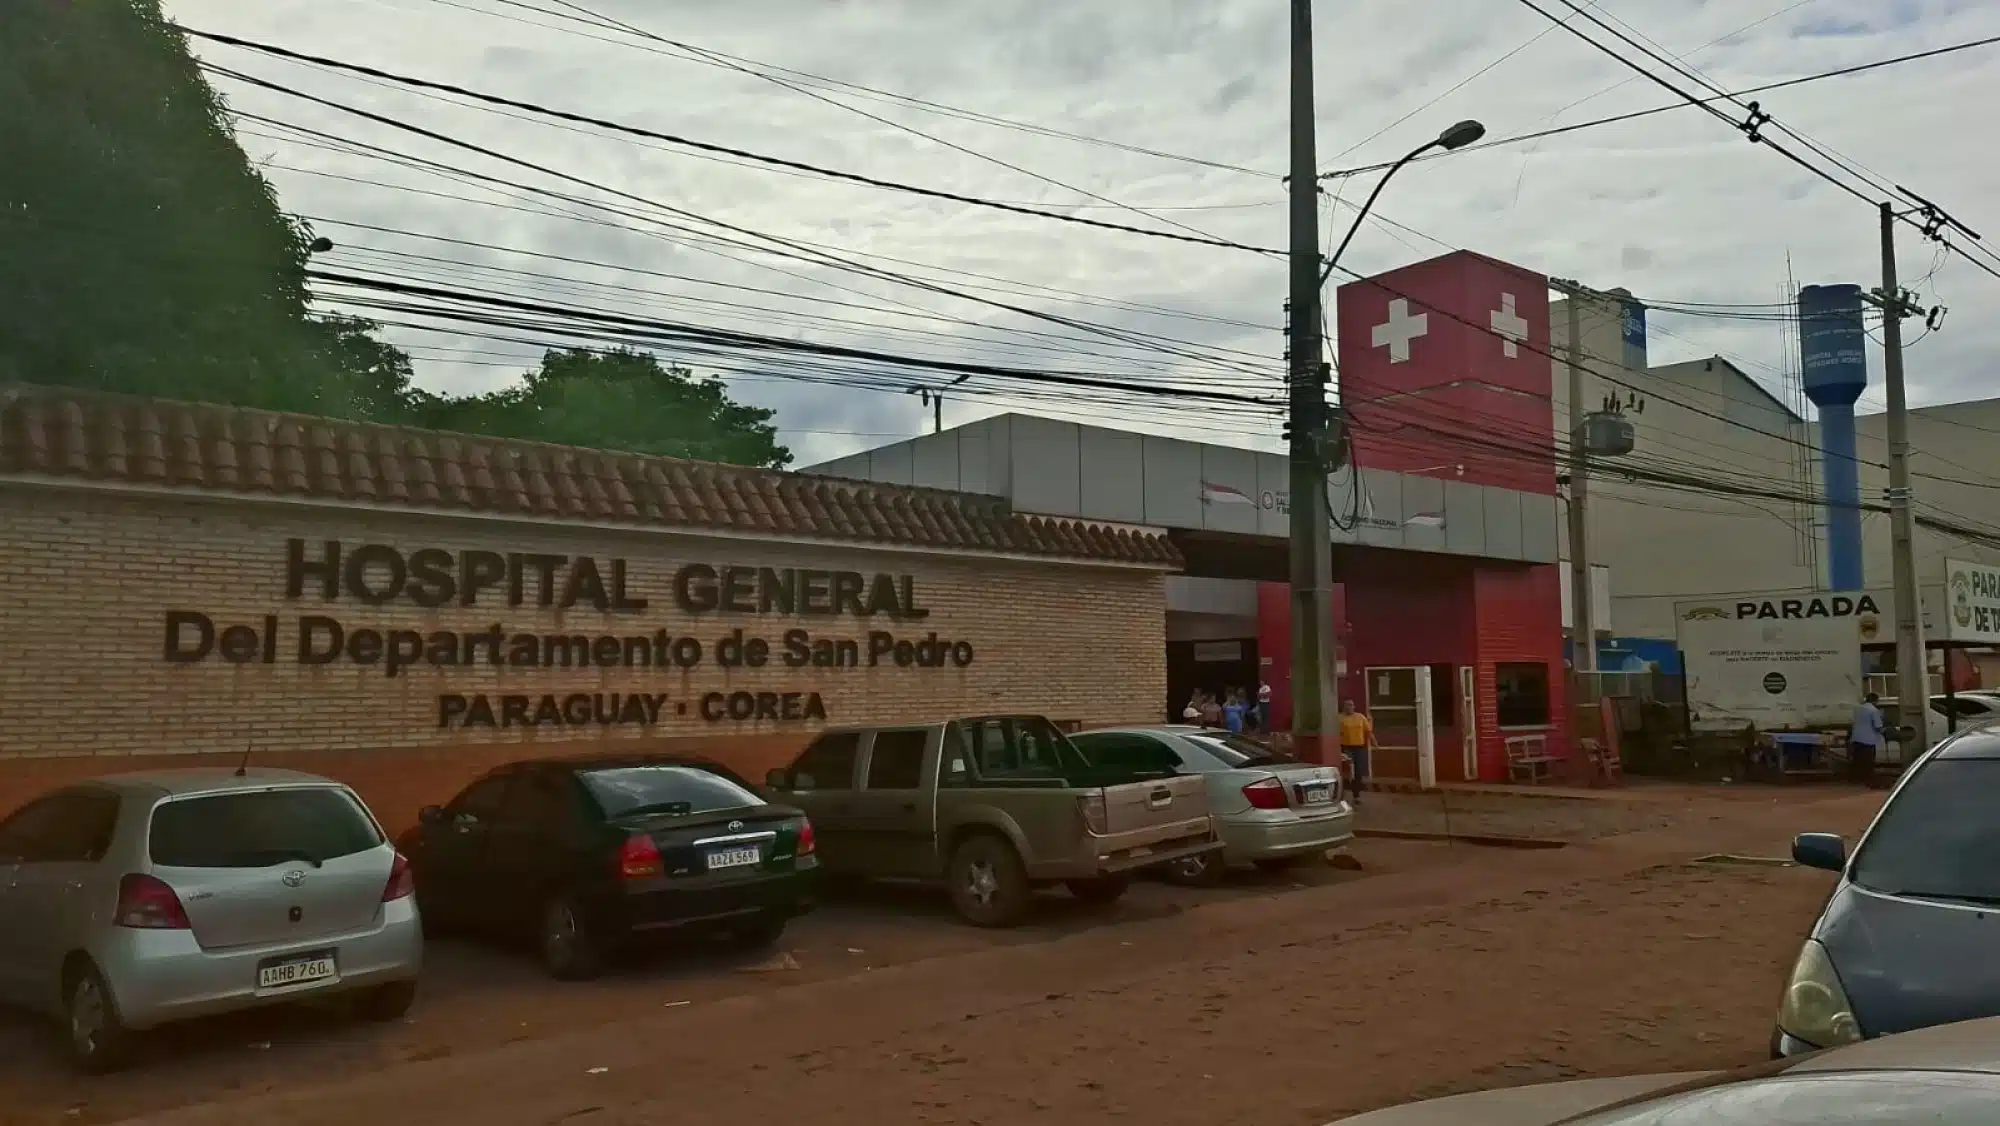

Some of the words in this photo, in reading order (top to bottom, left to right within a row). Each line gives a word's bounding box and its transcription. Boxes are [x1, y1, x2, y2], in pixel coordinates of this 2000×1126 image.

[286, 538, 648, 614] HOSPITAL
[672, 562, 930, 620] GENERAL
[1971, 570, 2000, 599] PAR
[1735, 595, 1880, 620] PARADA
[1974, 605, 1990, 633] DE
[164, 611, 278, 664] Del
[298, 614, 701, 678] Departamento
[715, 628, 770, 668] de
[781, 629, 859, 668] San
[867, 630, 975, 668] Pedro
[437, 692, 669, 728] PARAGUAY
[699, 691, 828, 723] COREA
[263, 965, 295, 984] AAHB
